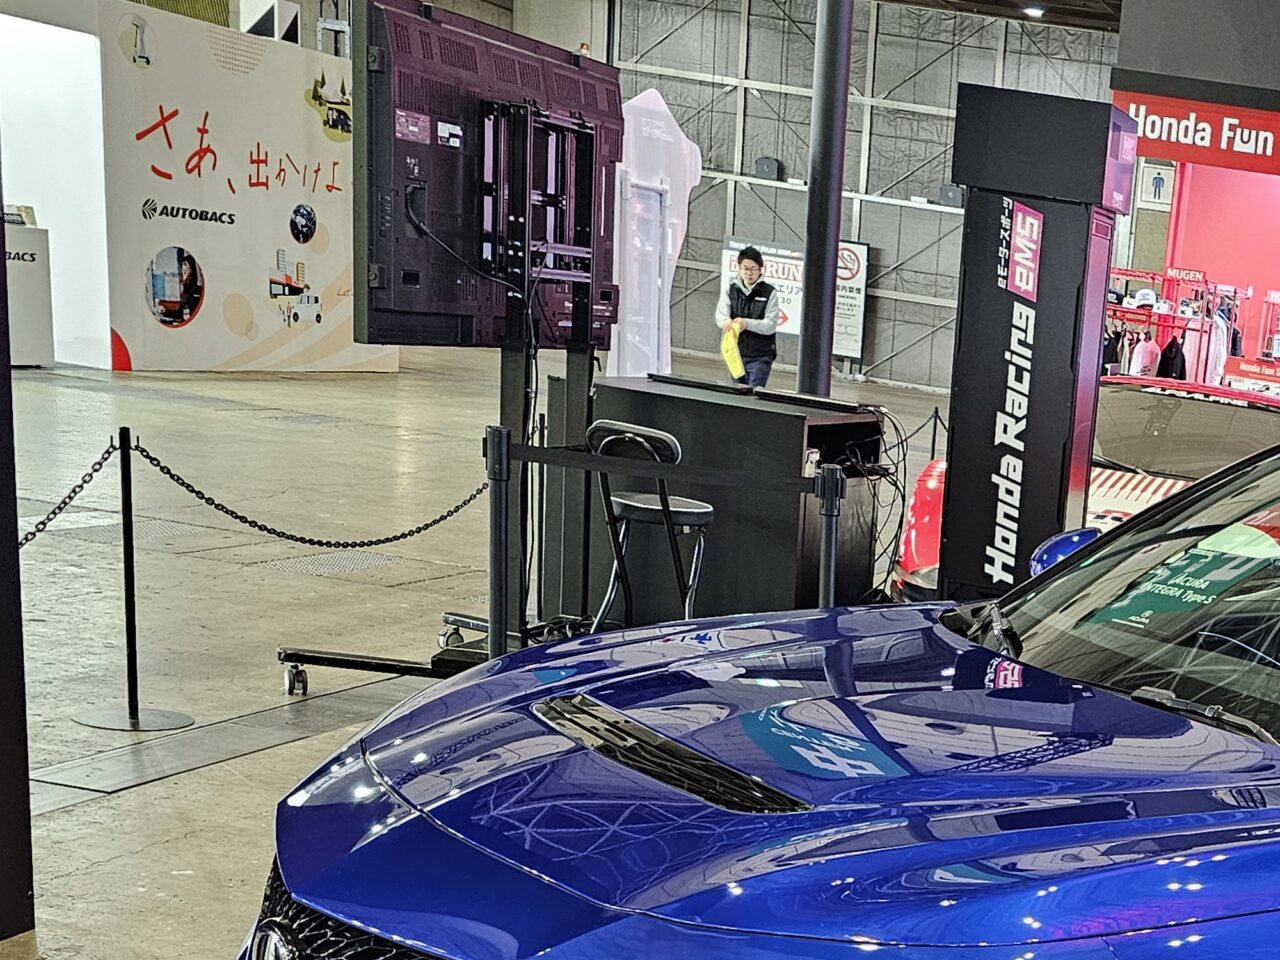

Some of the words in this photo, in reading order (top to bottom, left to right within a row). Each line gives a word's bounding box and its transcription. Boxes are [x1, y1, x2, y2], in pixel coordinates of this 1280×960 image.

[1129, 103, 1212, 148] Honda
[1220, 117, 1275, 157] Fun
[158, 205, 236, 225] AUTOBACS
[1166, 267, 1204, 282] MUGEN
[993, 300, 1037, 452] Racing
[983, 453, 1024, 586] Honda
[1174, 572, 1211, 590] ACURA
[1181, 590, 1206, 603] Type
